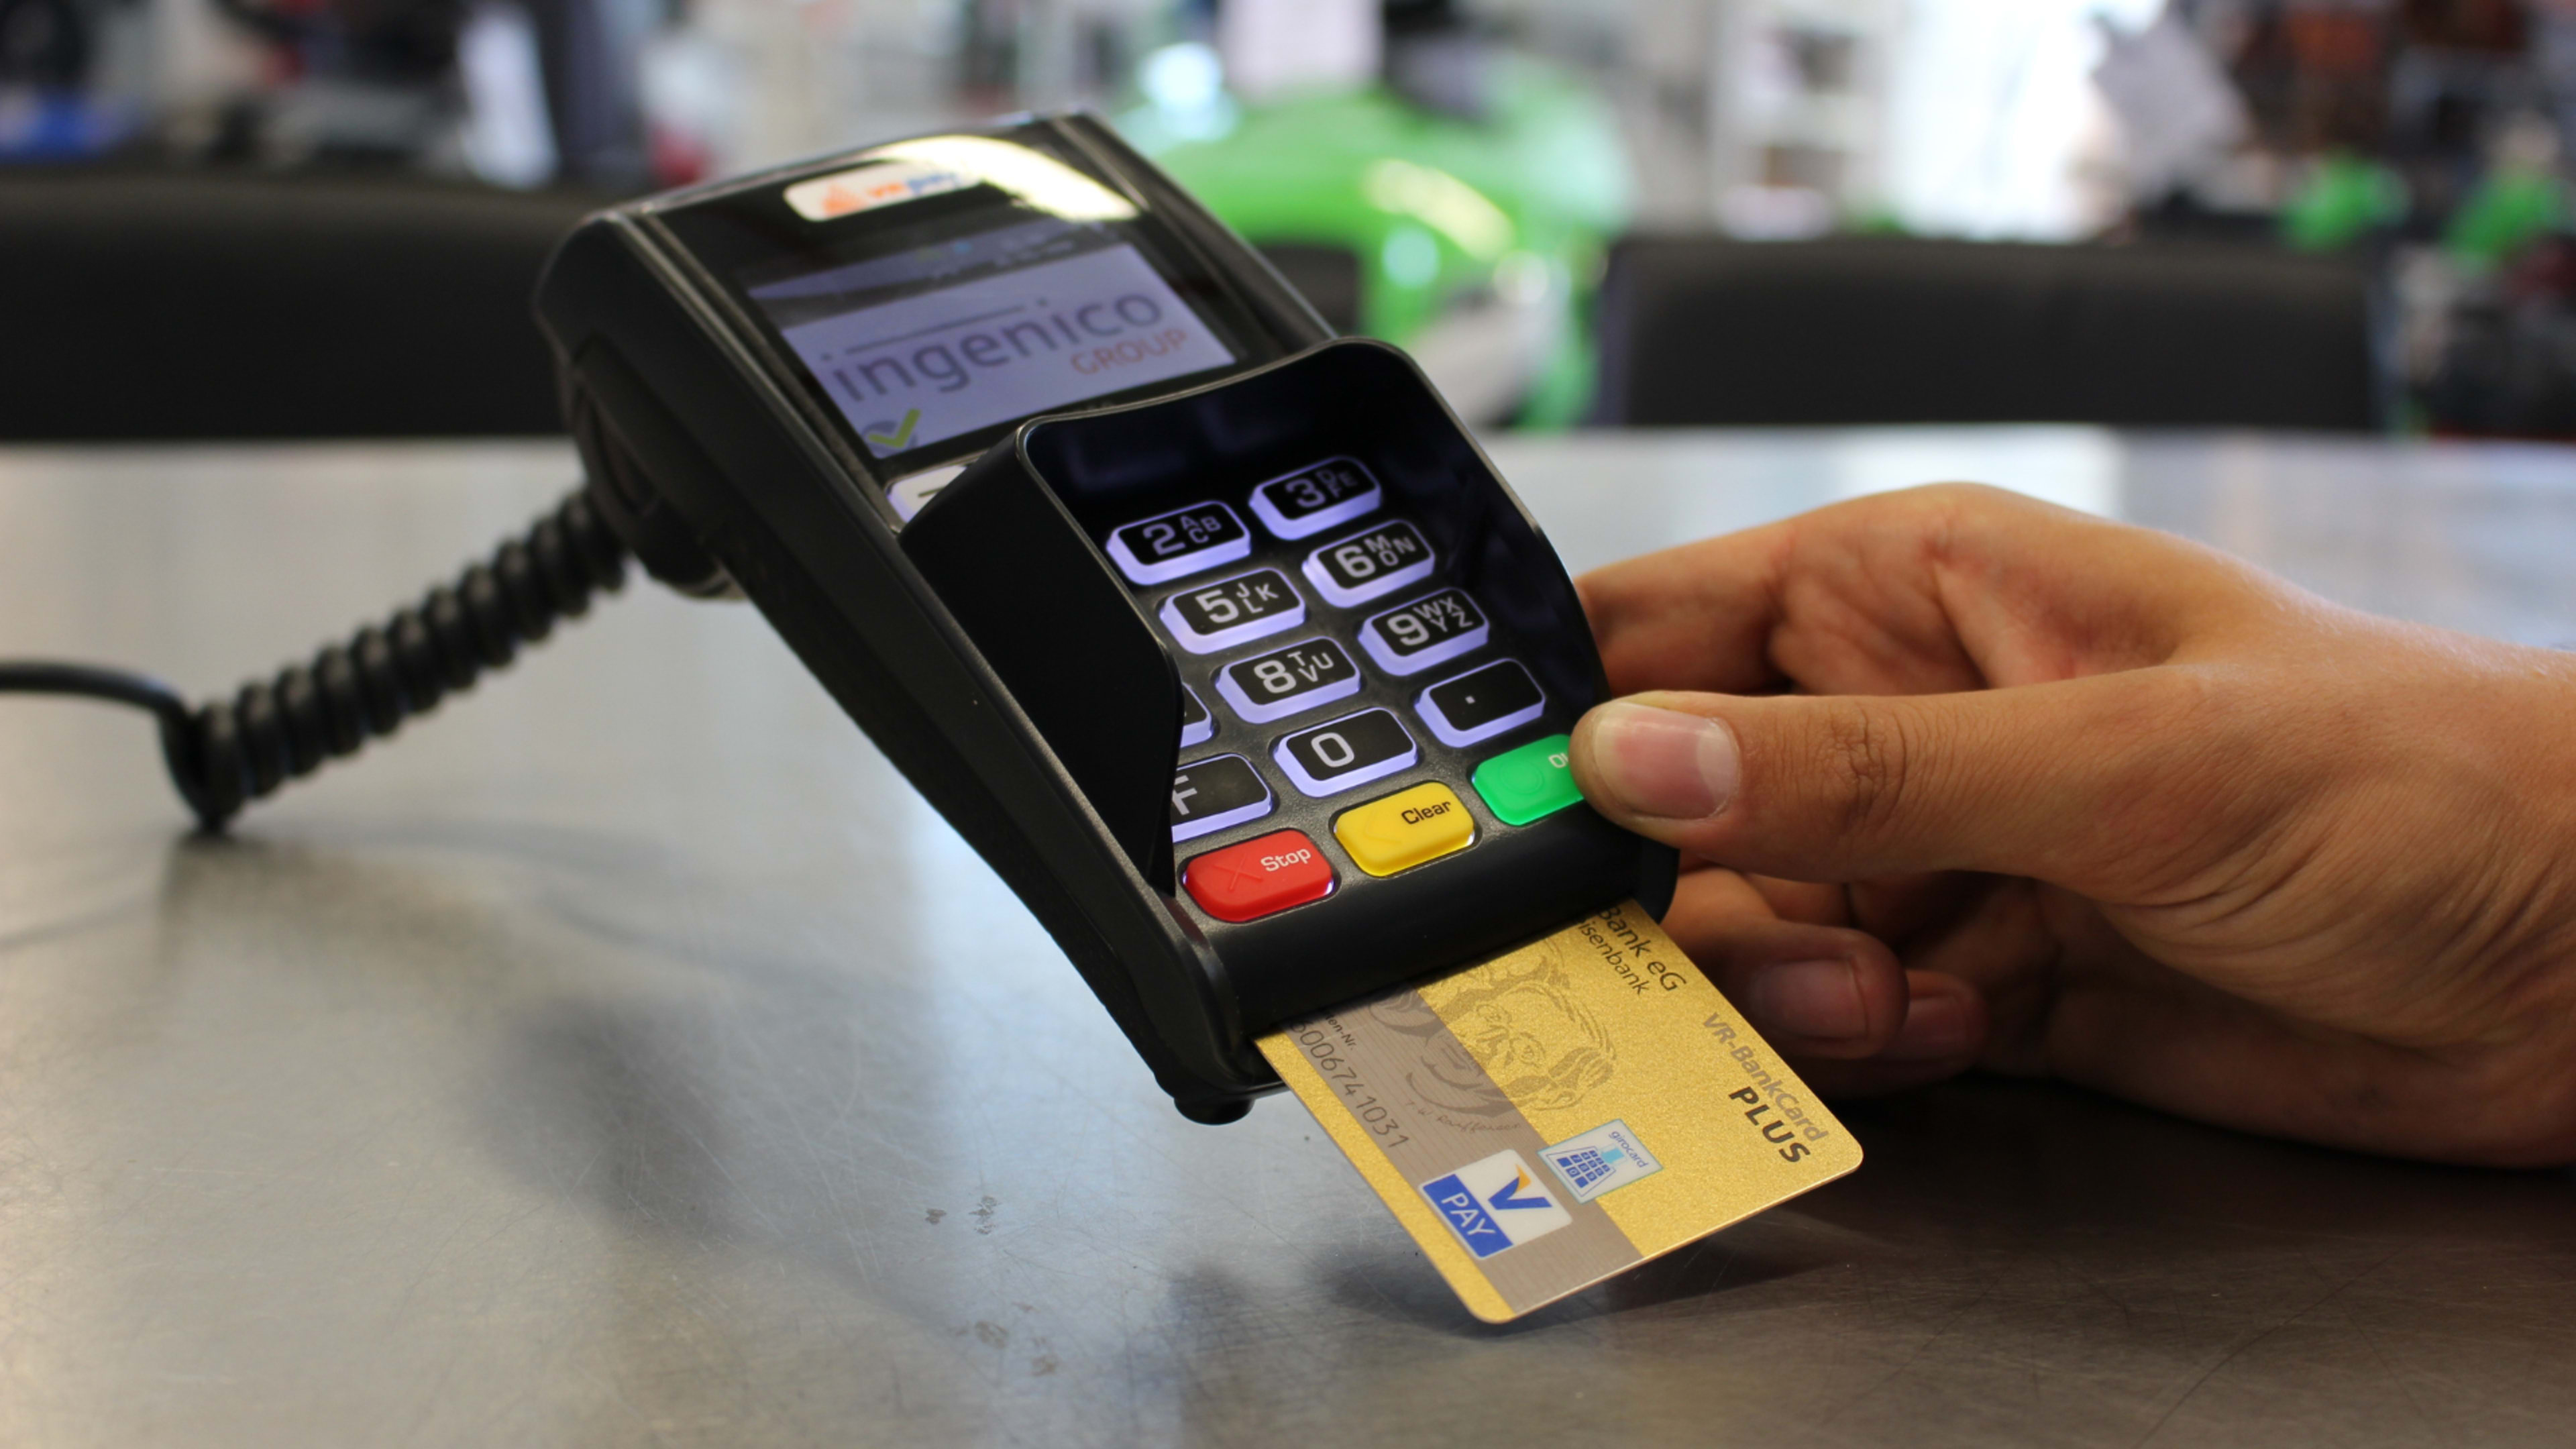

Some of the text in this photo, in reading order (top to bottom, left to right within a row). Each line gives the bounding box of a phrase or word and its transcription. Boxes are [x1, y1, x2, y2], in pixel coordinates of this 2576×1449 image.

[820, 292, 1163, 402] ingenico
[1069, 328, 1187, 376] GROUP
[1285, 478, 1327, 508] 3
[1143, 523, 1186, 556] 2
[1334, 545, 1376, 578] 6
[1195, 588, 1240, 624] 5
[1387, 613, 1430, 646] 9
[1253, 659, 1297, 694] 8
[1401, 801, 1451, 825] Clear
[1260, 848, 1312, 872] Stop
[1647, 961, 1687, 991] eG
[1703, 1012, 1829, 1142] VR-BankCard
[1728, 1085, 1811, 1163] PLUS
[1608, 1130, 1649, 1169] girocard
[1440, 1192, 1497, 1236] PAY
